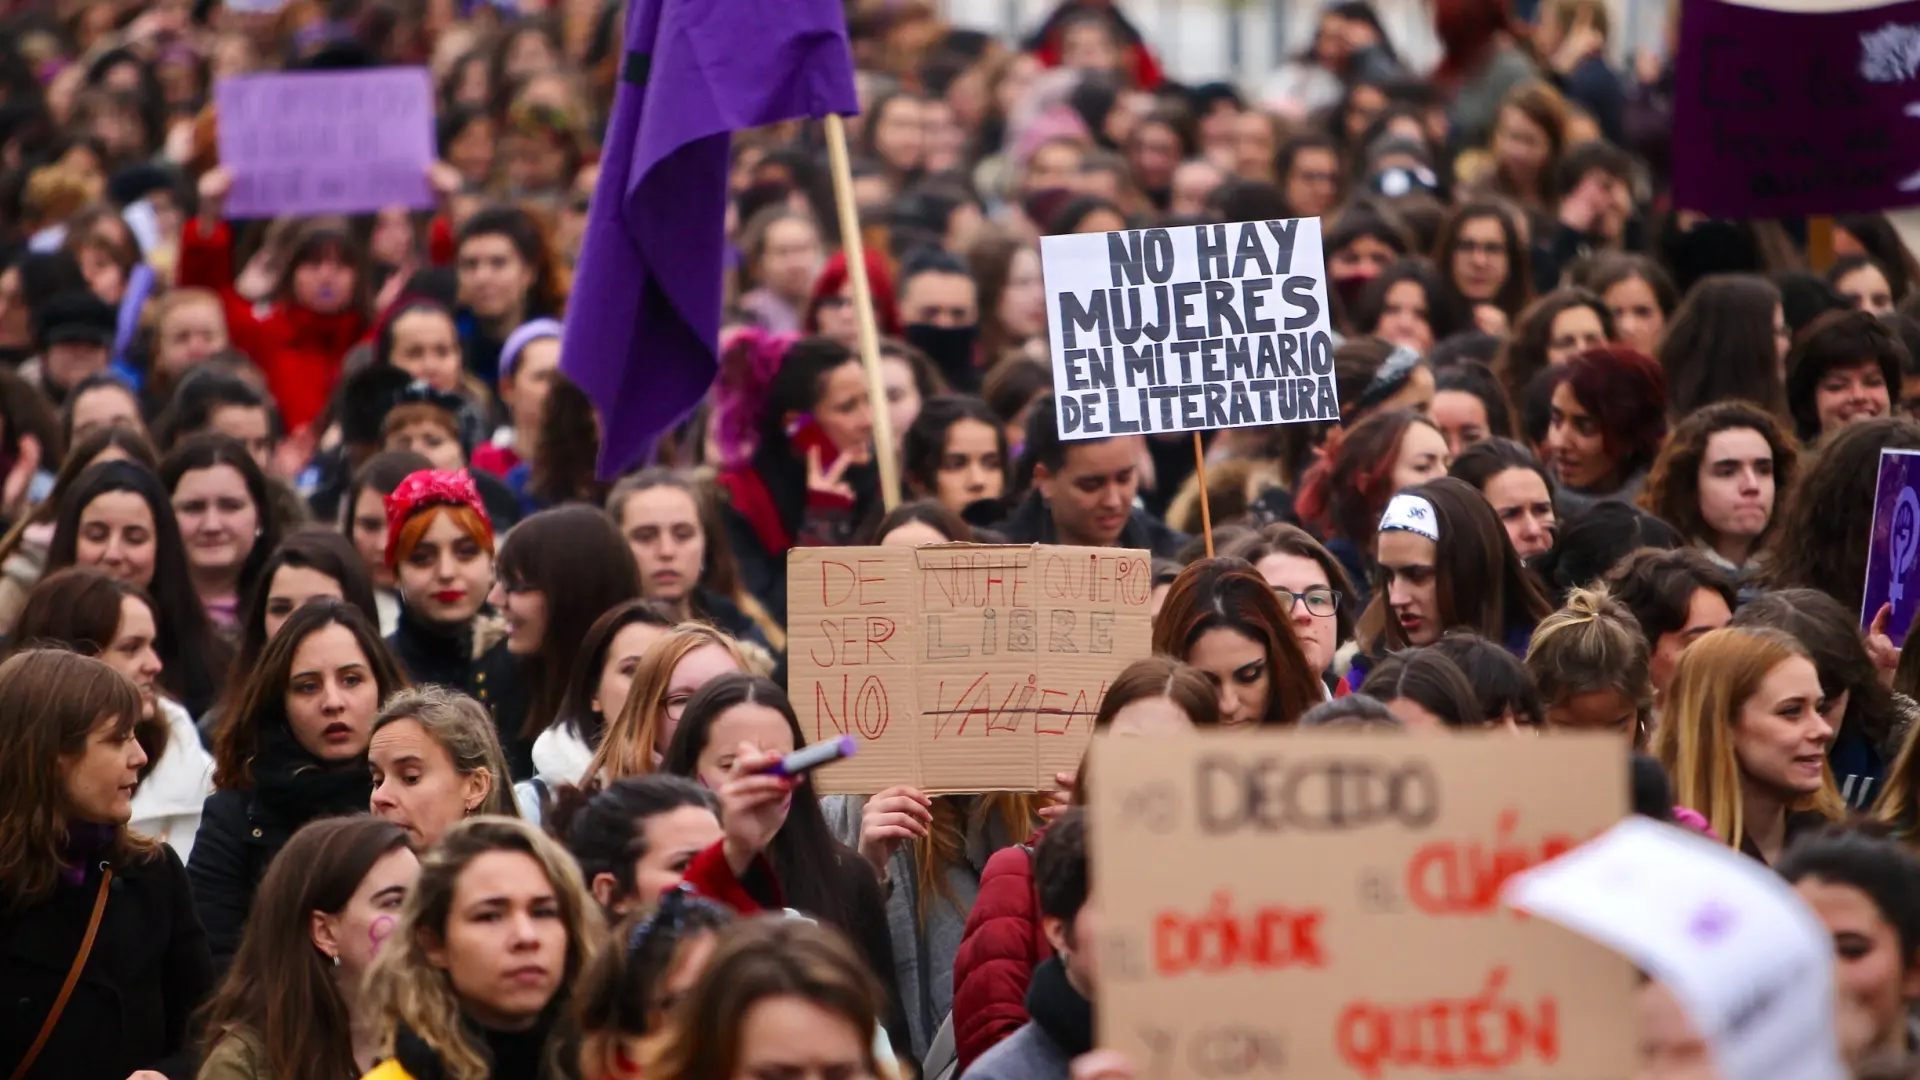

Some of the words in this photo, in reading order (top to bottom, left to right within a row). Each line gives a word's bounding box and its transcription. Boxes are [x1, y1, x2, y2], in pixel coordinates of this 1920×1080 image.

[1107, 228, 1174, 287] NO
[1195, 219, 1300, 281] HAY
[1059, 275, 1320, 349] MUJERES
[1064, 347, 1116, 391] EN
[1123, 342, 1166, 387] MI
[1170, 330, 1333, 384] TEMARIO
[1060, 393, 1104, 434] DE
[1107, 376, 1339, 434] LITERATURA
[821, 559, 886, 608] DE
[922, 552, 1030, 608] NOCHE
[810, 616, 896, 668] SER
[816, 673, 889, 741] NO
[1195, 756, 1440, 835] DECIDO
[1333, 962, 1560, 1080] QUIÉN
